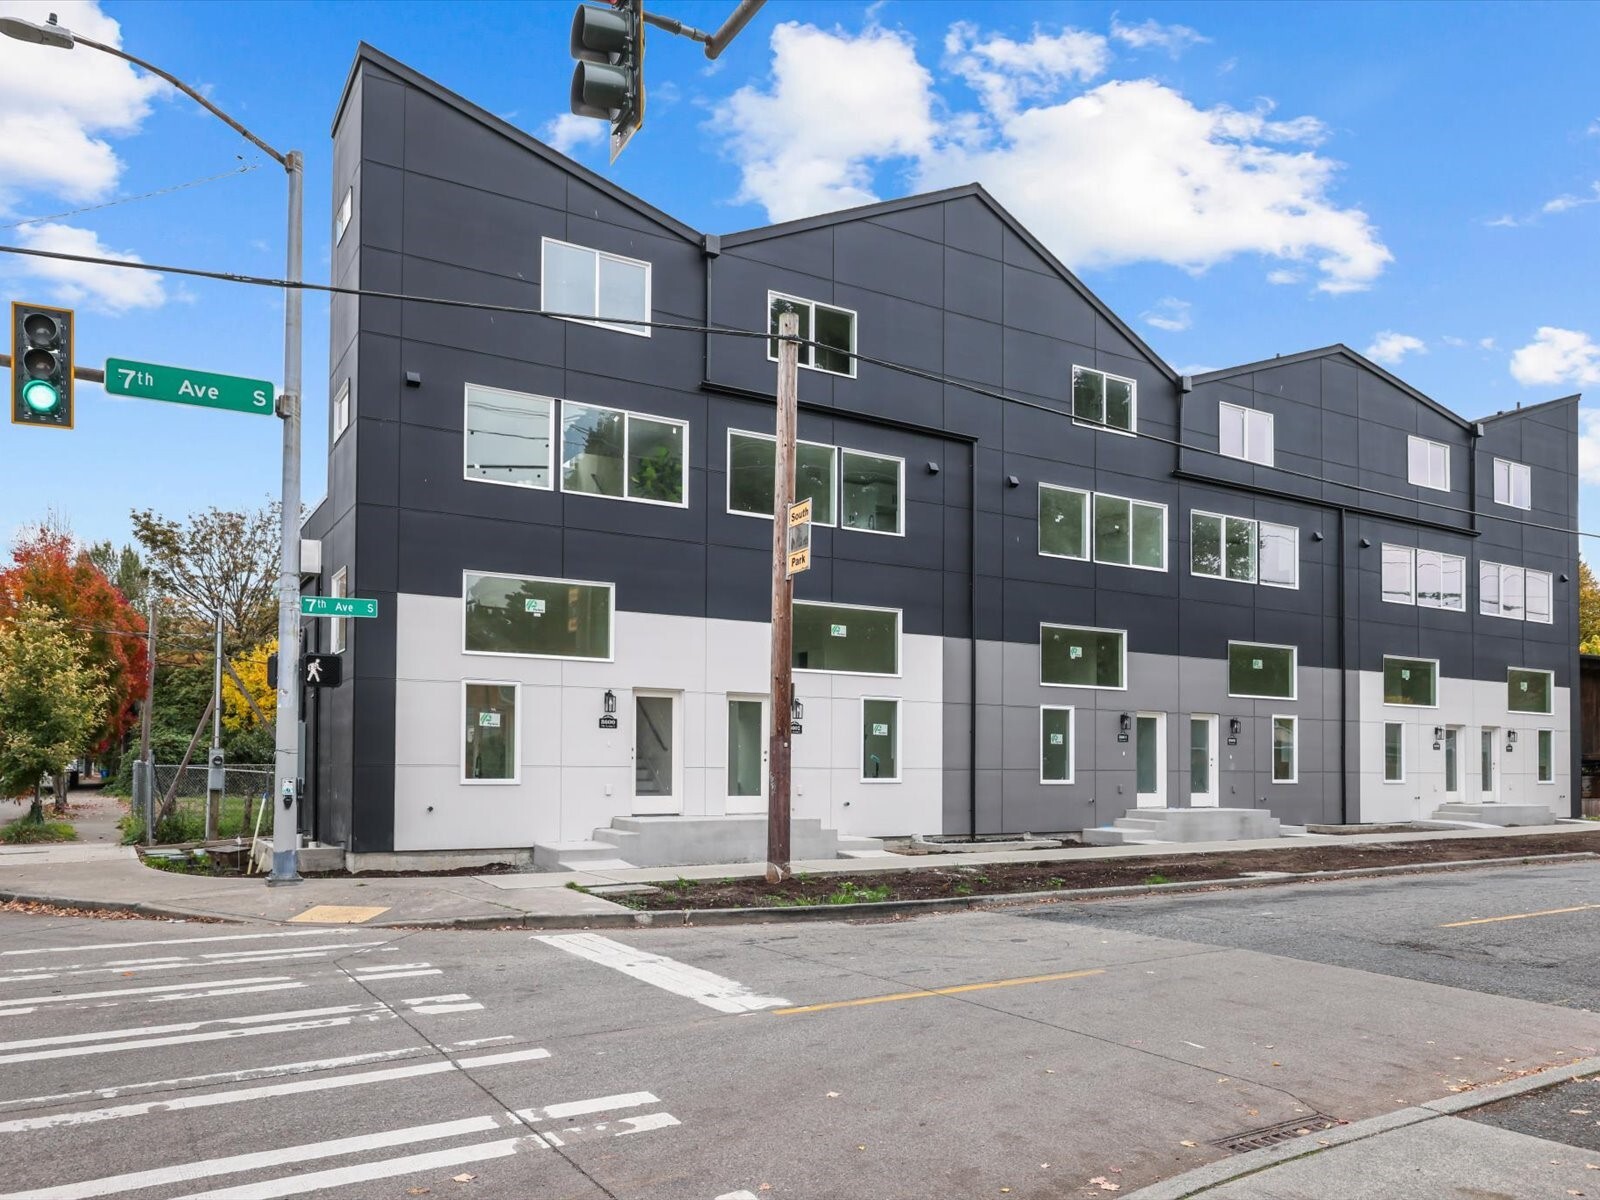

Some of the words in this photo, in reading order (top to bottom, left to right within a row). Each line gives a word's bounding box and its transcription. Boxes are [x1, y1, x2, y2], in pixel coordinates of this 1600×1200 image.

[118, 368, 153, 389] 7th
[178, 379, 219, 400] Ave
[253, 390, 266, 406] S
[791, 507, 809, 522] South
[791, 554, 806, 567] Park
[305, 598, 327, 612] 7th
[335, 602, 354, 612] Ave
[367, 603, 374, 613] S
